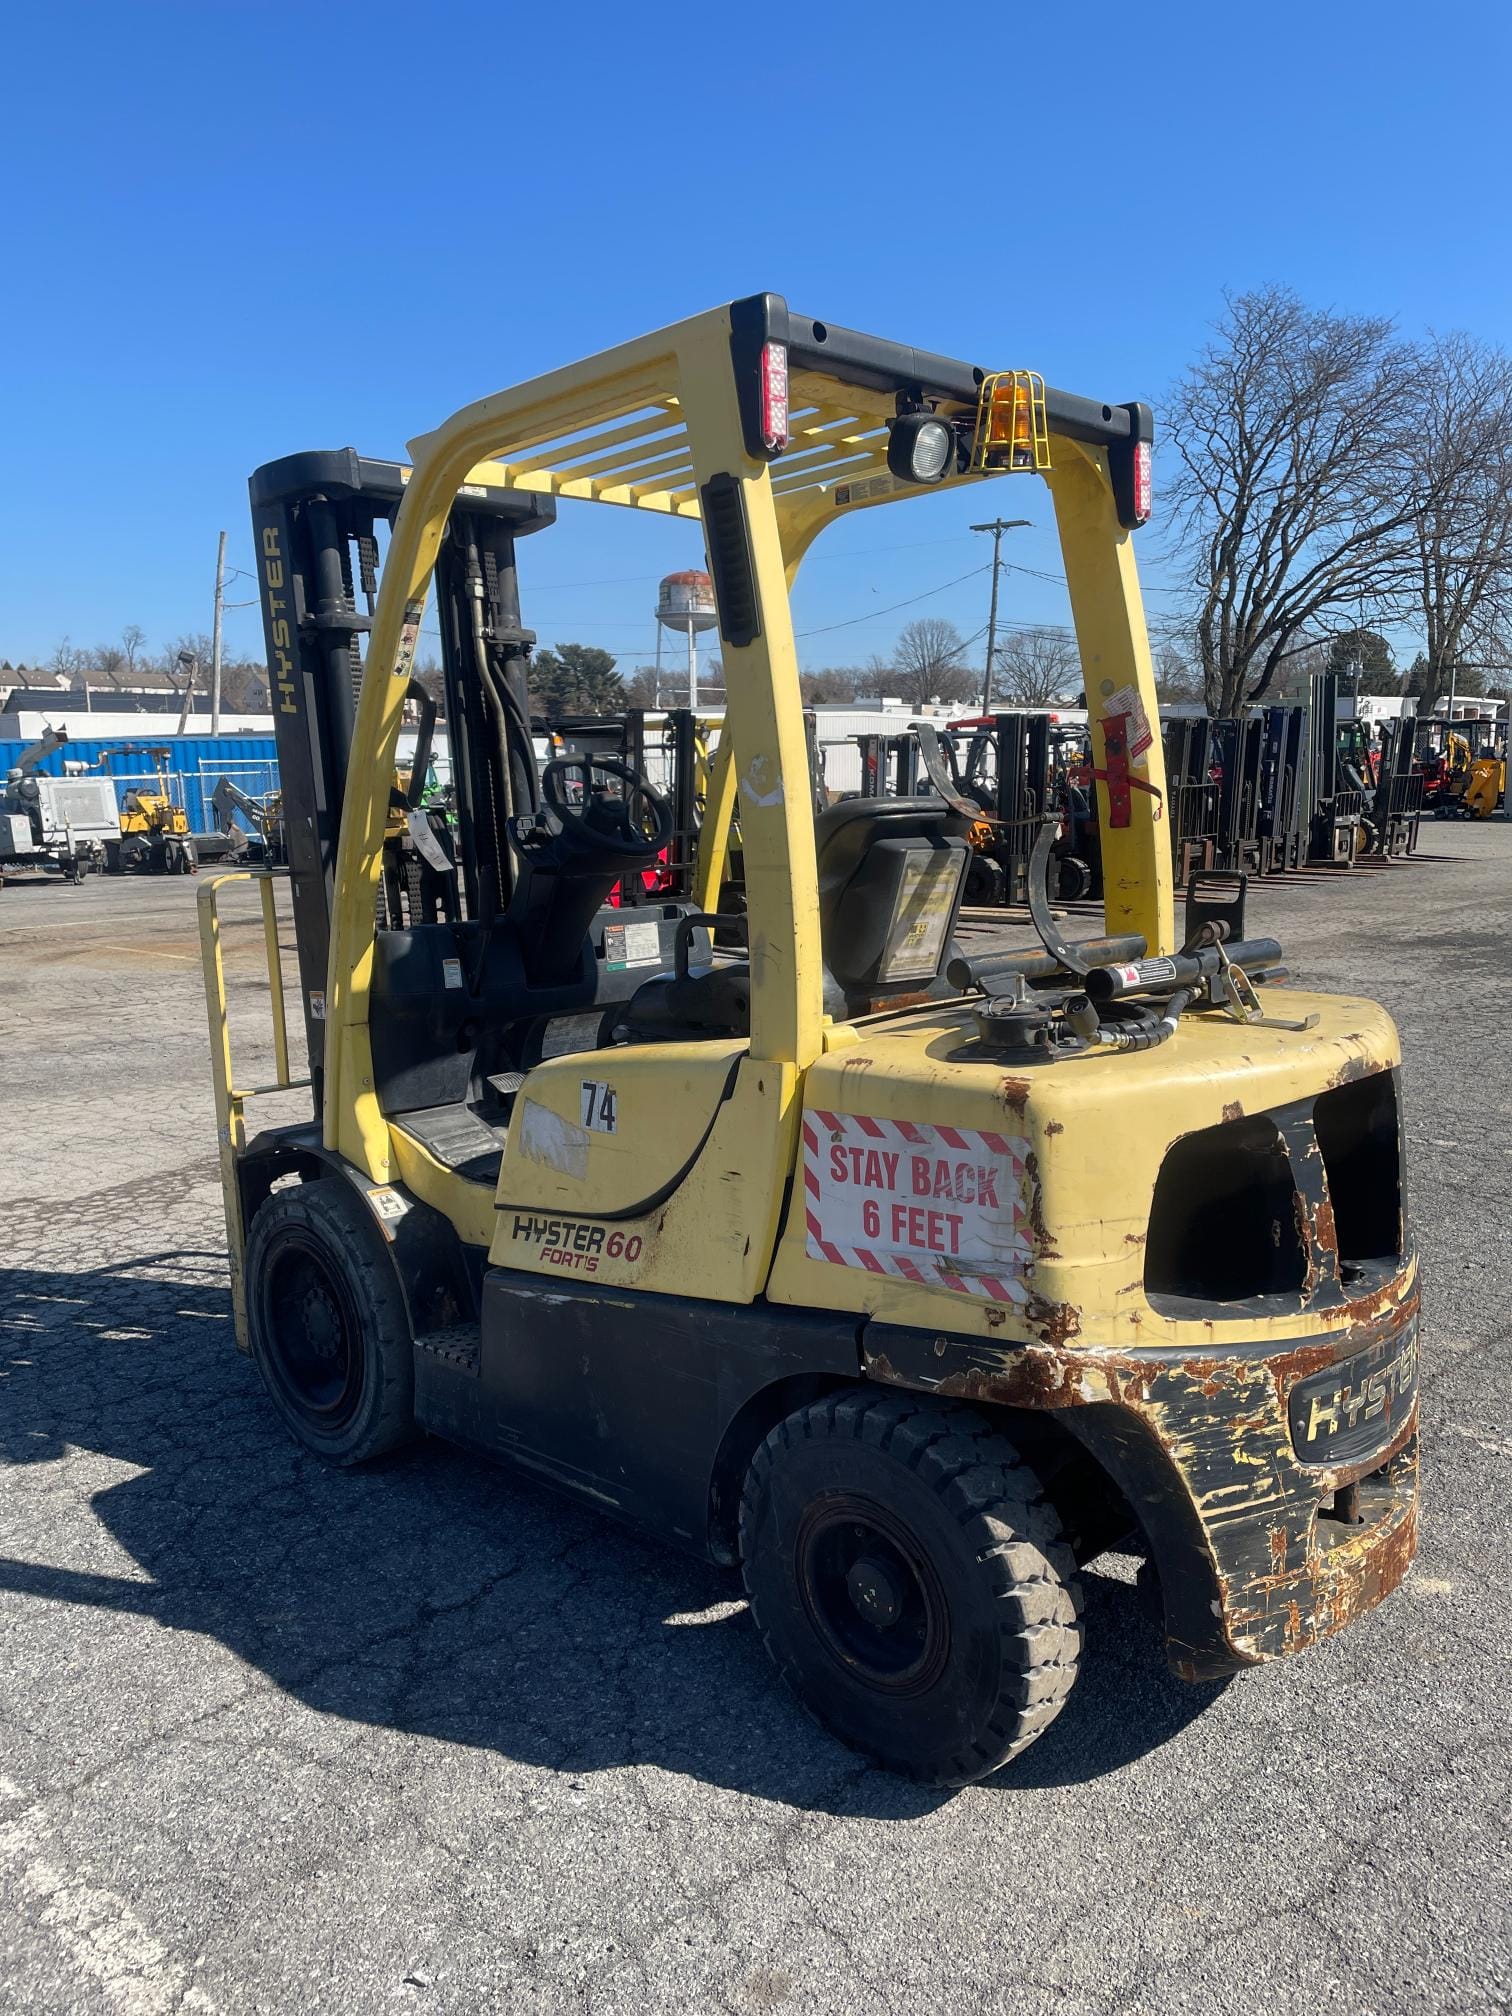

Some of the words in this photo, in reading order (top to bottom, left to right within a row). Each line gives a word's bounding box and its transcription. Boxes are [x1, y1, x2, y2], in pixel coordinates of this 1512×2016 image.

[262, 527, 297, 714] HYSTER
[582, 1082, 616, 1131] 74
[830, 1144, 899, 1191] STAY
[911, 1155, 1000, 1208] BACK
[511, 1215, 606, 1254] HYSTER
[606, 1231, 643, 1262] 60
[863, 1200, 880, 1239] 6
[891, 1203, 963, 1255] FEET
